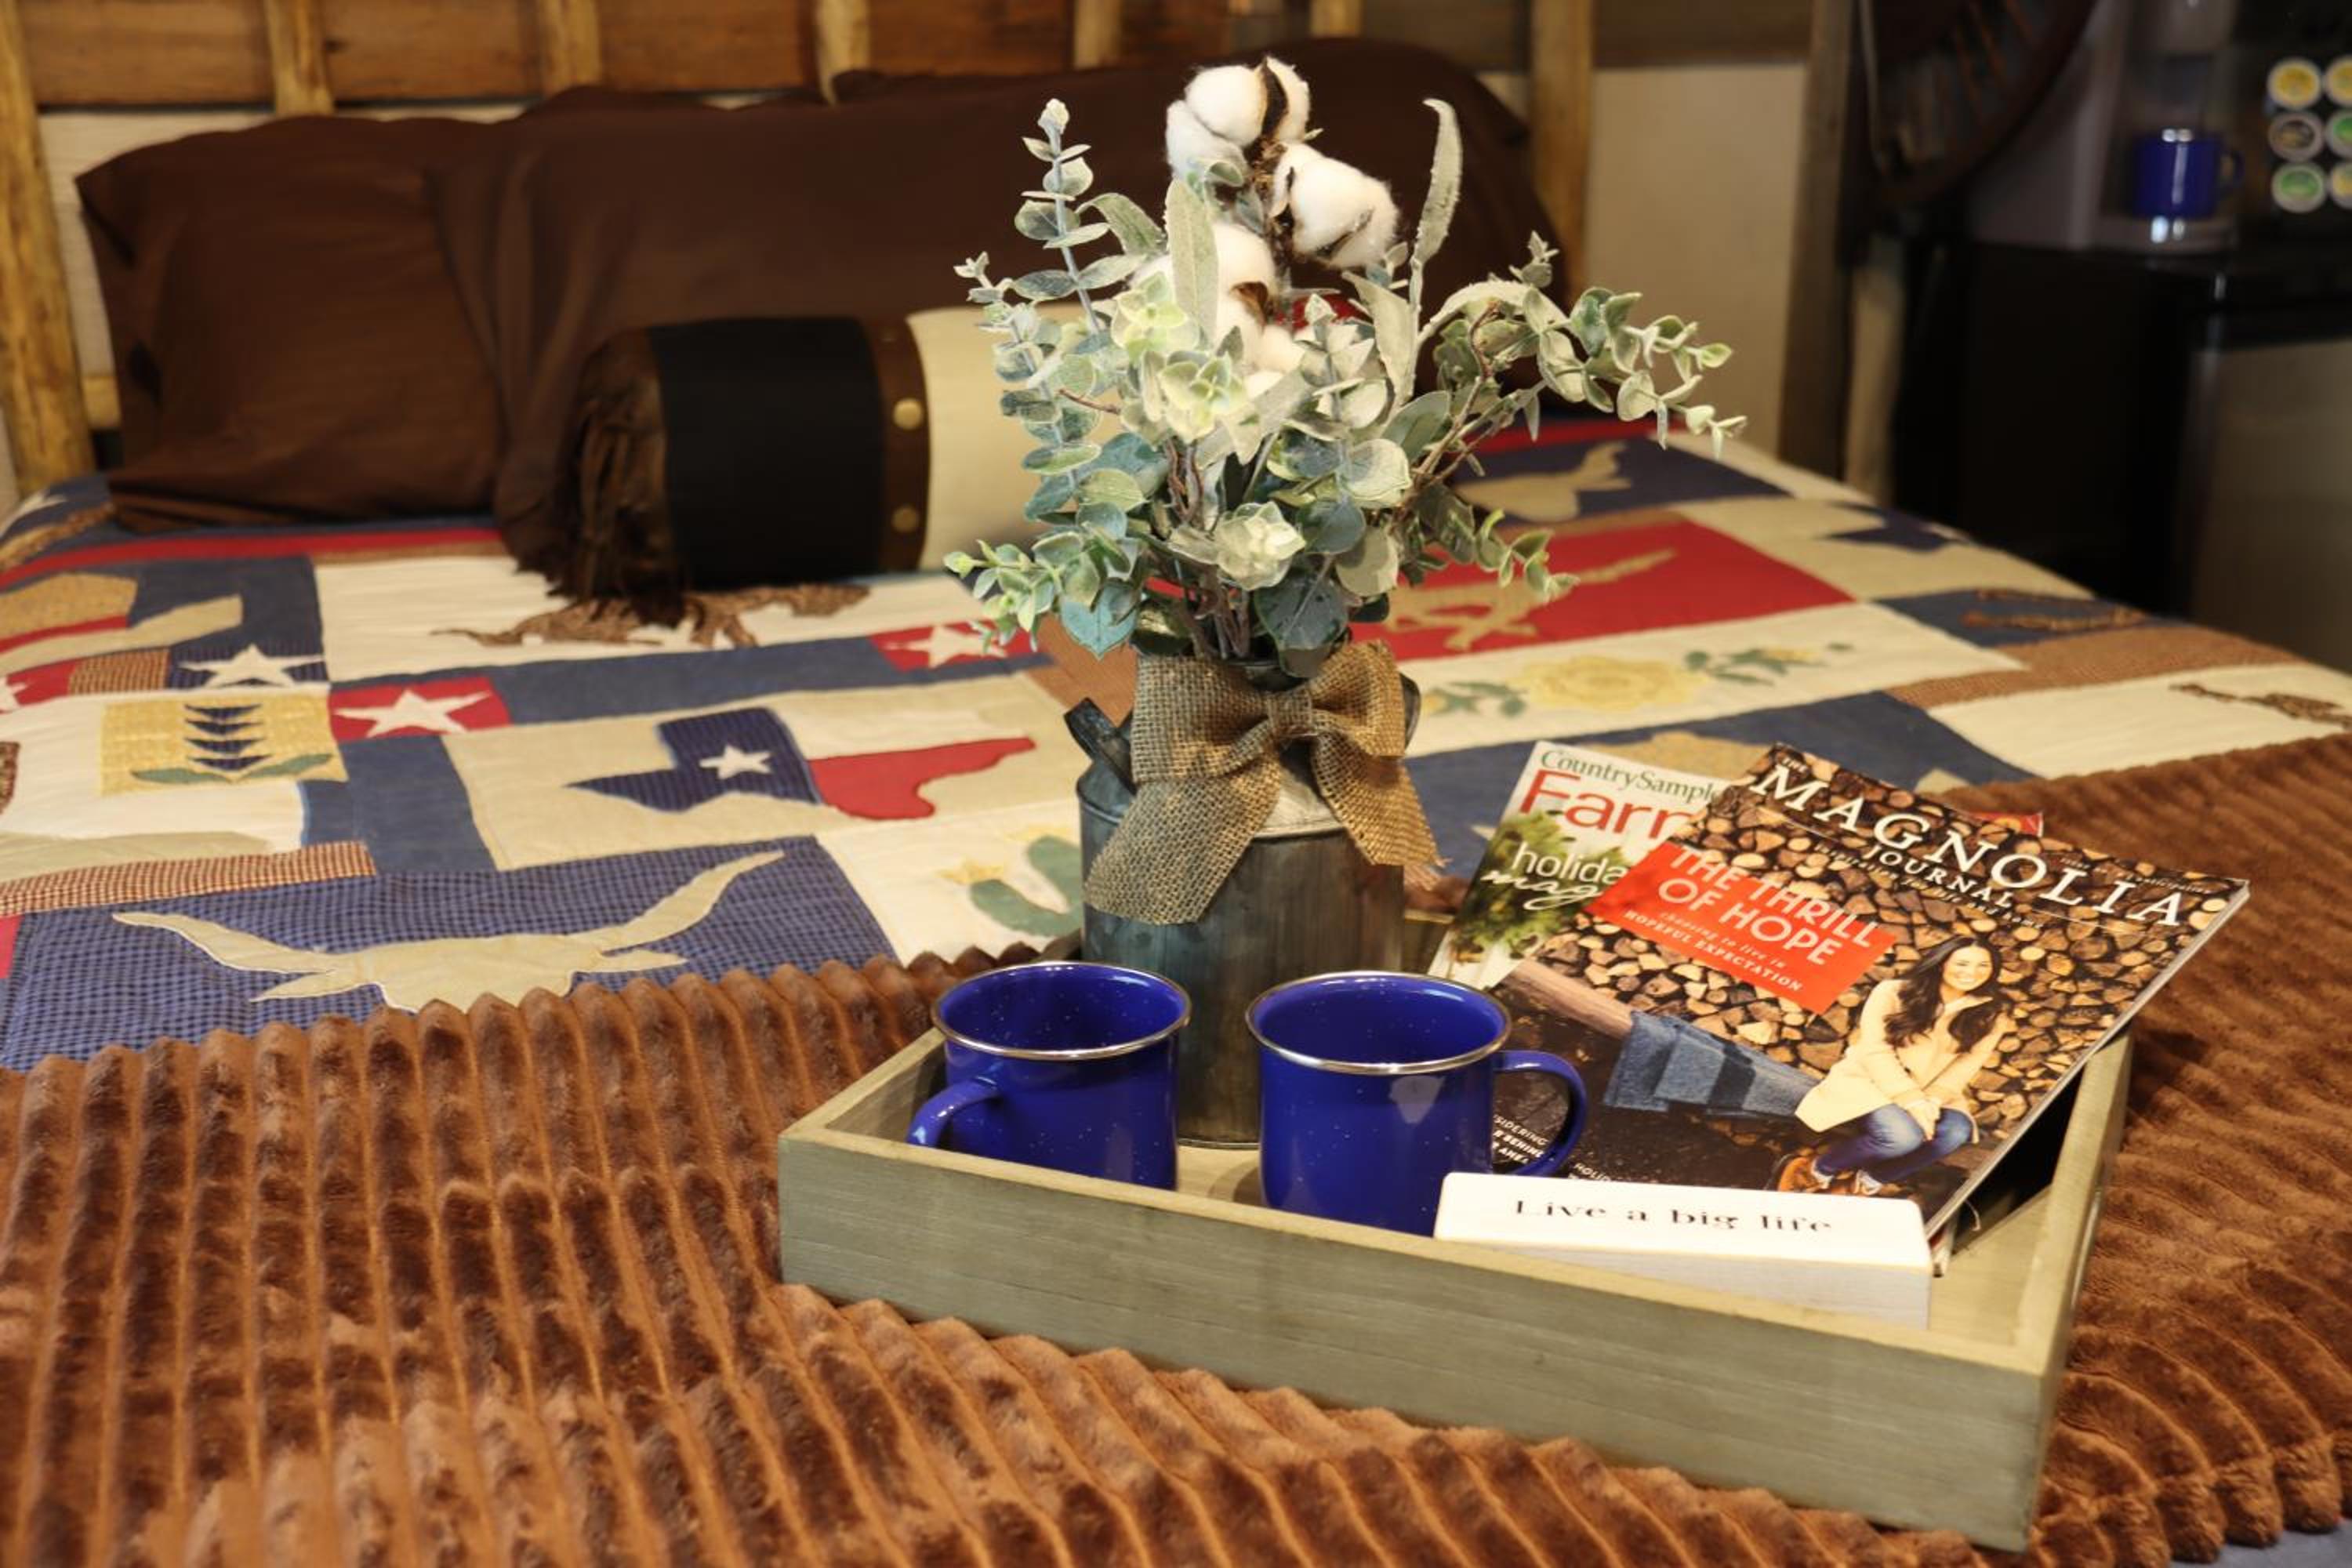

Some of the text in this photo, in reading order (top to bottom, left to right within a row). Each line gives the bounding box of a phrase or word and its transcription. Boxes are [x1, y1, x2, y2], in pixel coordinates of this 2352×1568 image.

[1749, 764, 2185, 927] MAGNOLIA
[1862, 844, 2014, 909] JOURNAL
[1658, 878, 1842, 966] OF HOPE
[1670, 844, 1879, 949] THE THRILL
[1624, 910, 1803, 992] HOPEFUL EXPECTATION
[1493, 1114, 1550, 1146] SIDERING
[1515, 1200, 1833, 1232] Live a big life
